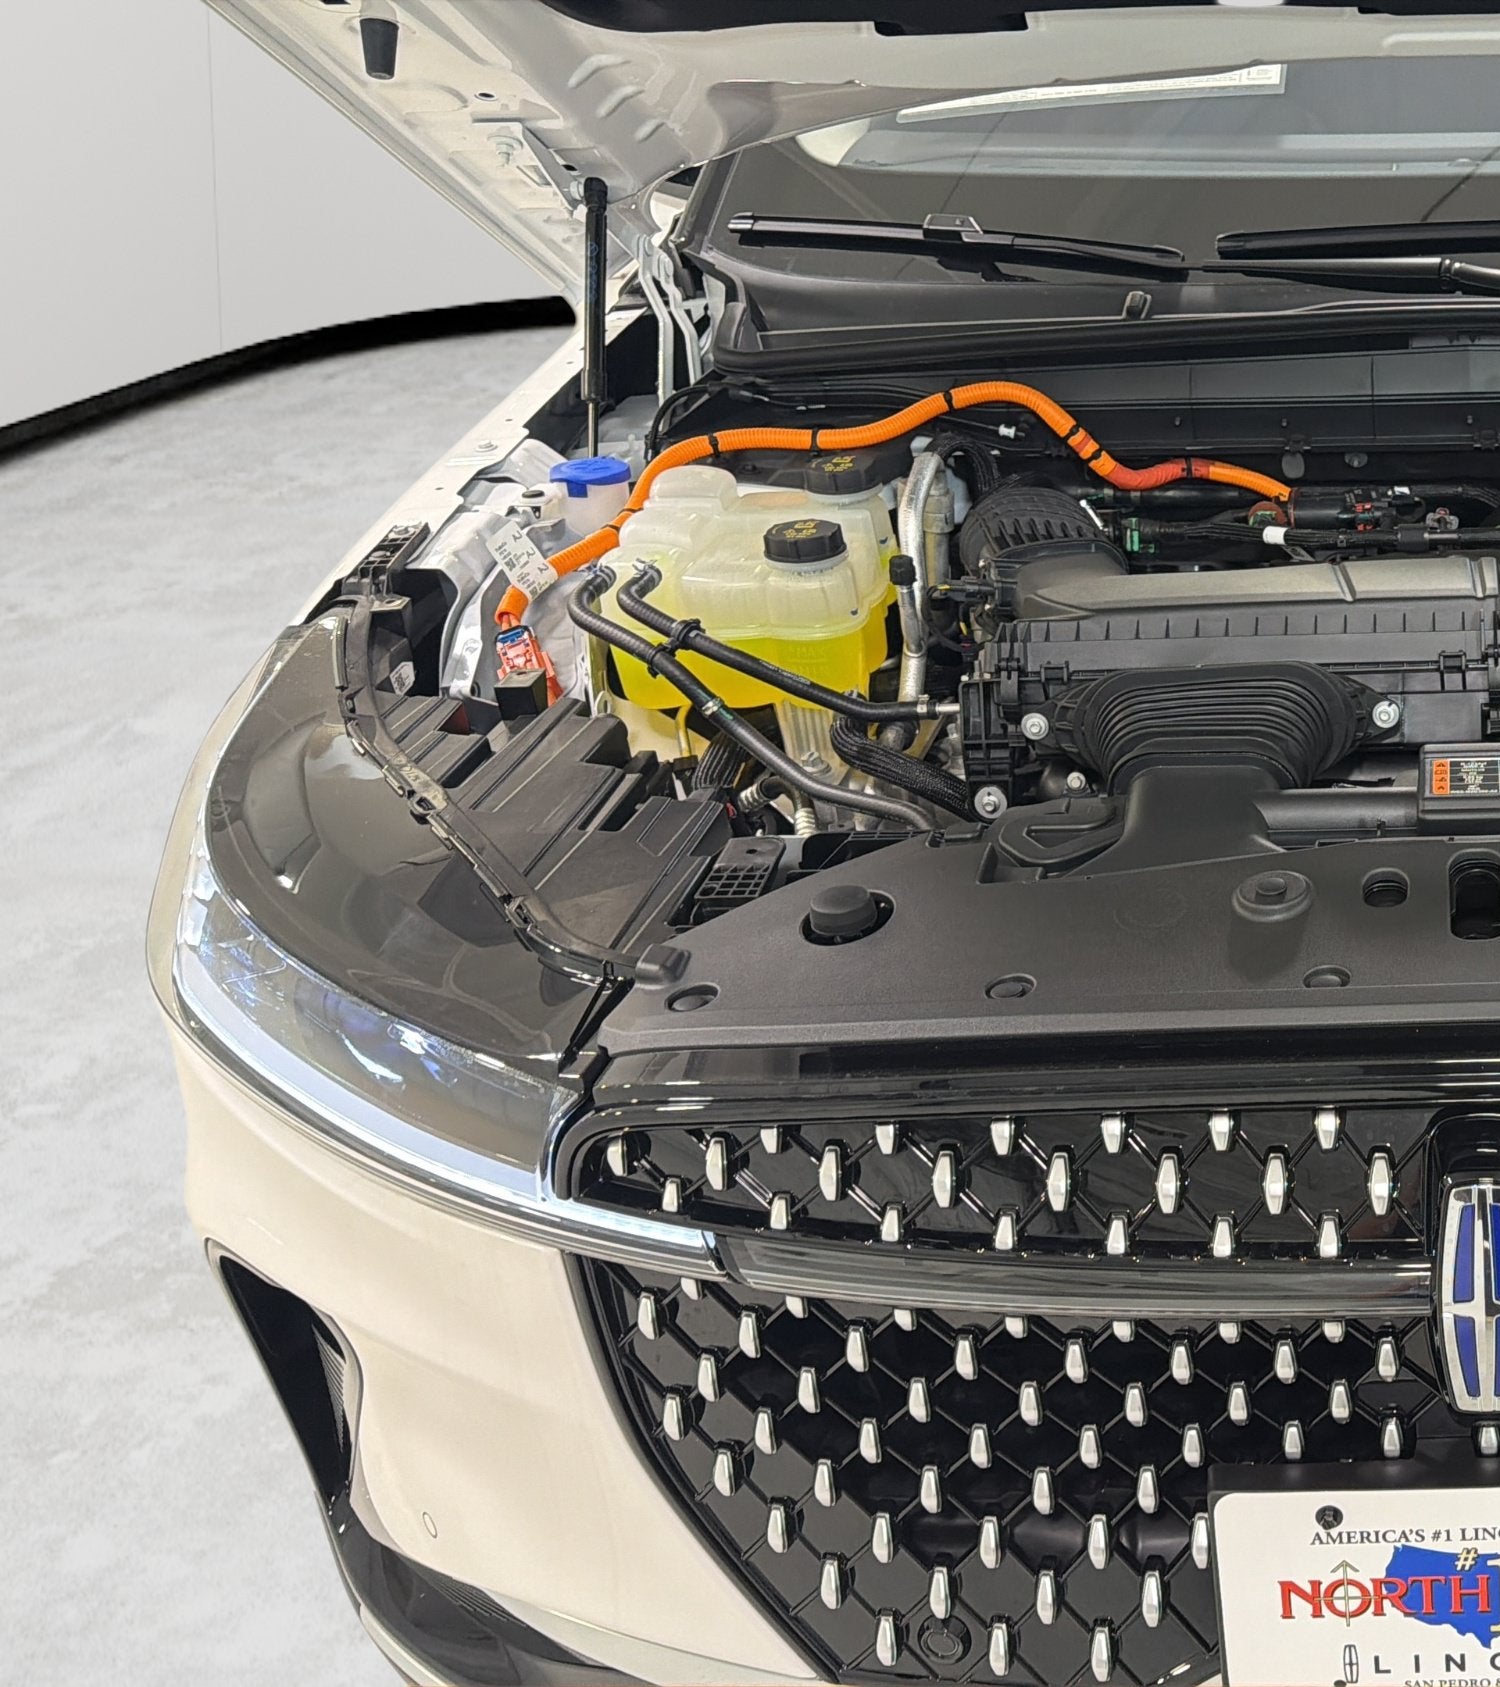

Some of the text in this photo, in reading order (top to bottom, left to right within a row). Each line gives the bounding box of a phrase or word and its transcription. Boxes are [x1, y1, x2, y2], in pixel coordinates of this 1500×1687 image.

[1310, 1528, 1426, 1546] AMERICA'S
[1431, 1528, 1453, 1543] #1
[1278, 1574, 1491, 1619] NORTH
[1405, 1679, 1436, 1687] SAN
[1438, 1678, 1491, 1687] PEDRO
